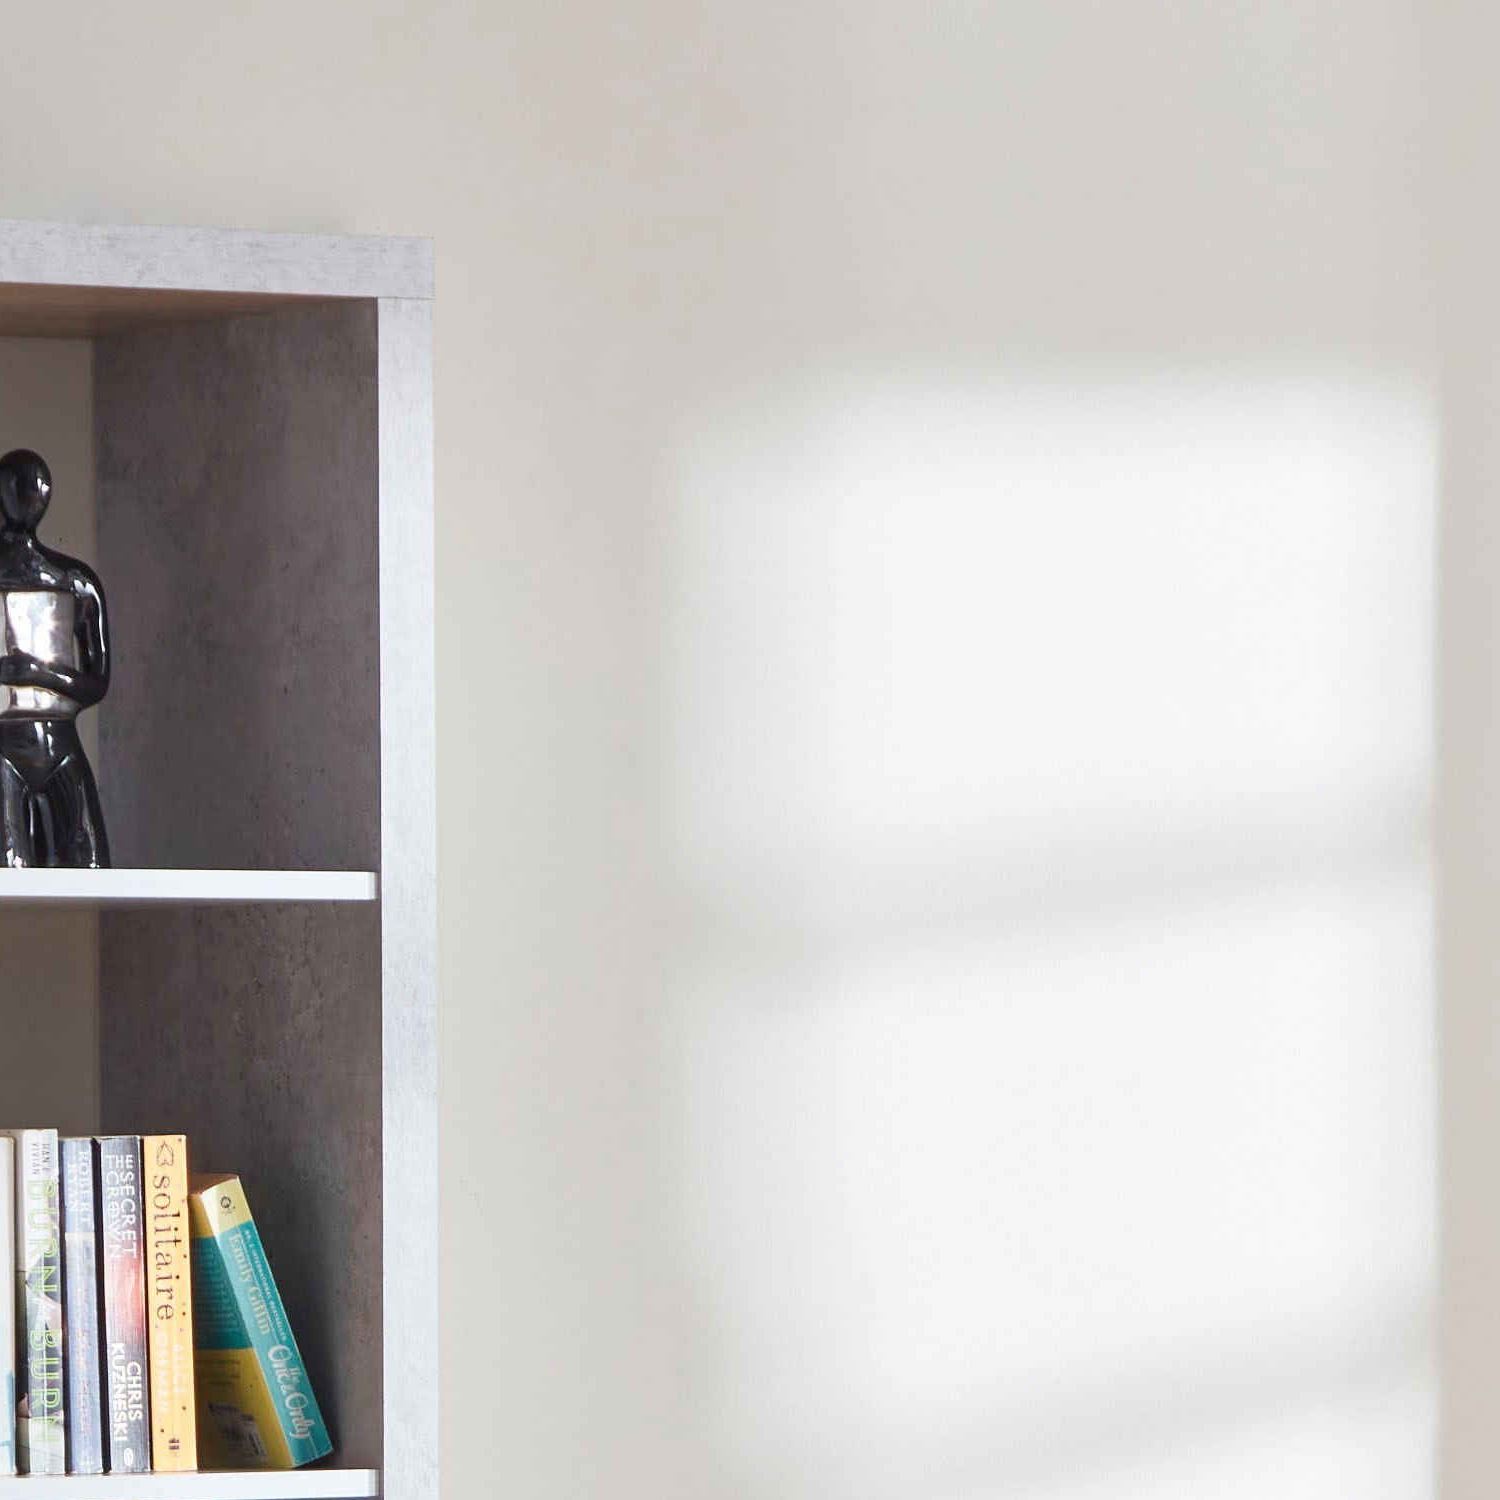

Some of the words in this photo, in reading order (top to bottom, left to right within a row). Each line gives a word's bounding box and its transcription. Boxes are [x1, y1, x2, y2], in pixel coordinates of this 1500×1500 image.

[32, 1142, 41, 1175] VIVIAN
[68, 1164, 78, 1212] RYAN
[79, 1151, 91, 1224] ROBERT
[106, 1154, 134, 1169] THE
[27, 1180, 58, 1292] BURN
[105, 1171, 122, 1258] CROWN
[120, 1171, 137, 1258] SECRET
[152, 1175, 181, 1321] solitaire
[228, 1232, 255, 1284] Emily
[247, 1285, 271, 1336] Giffin
[29, 1330, 61, 1444] BURN
[111, 1342, 129, 1441] KUZNESKI
[127, 1361, 143, 1421] CHRIS
[155, 1333, 170, 1413] OSEMAN
[267, 1344, 293, 1387] One
[284, 1392, 316, 1440] Only
